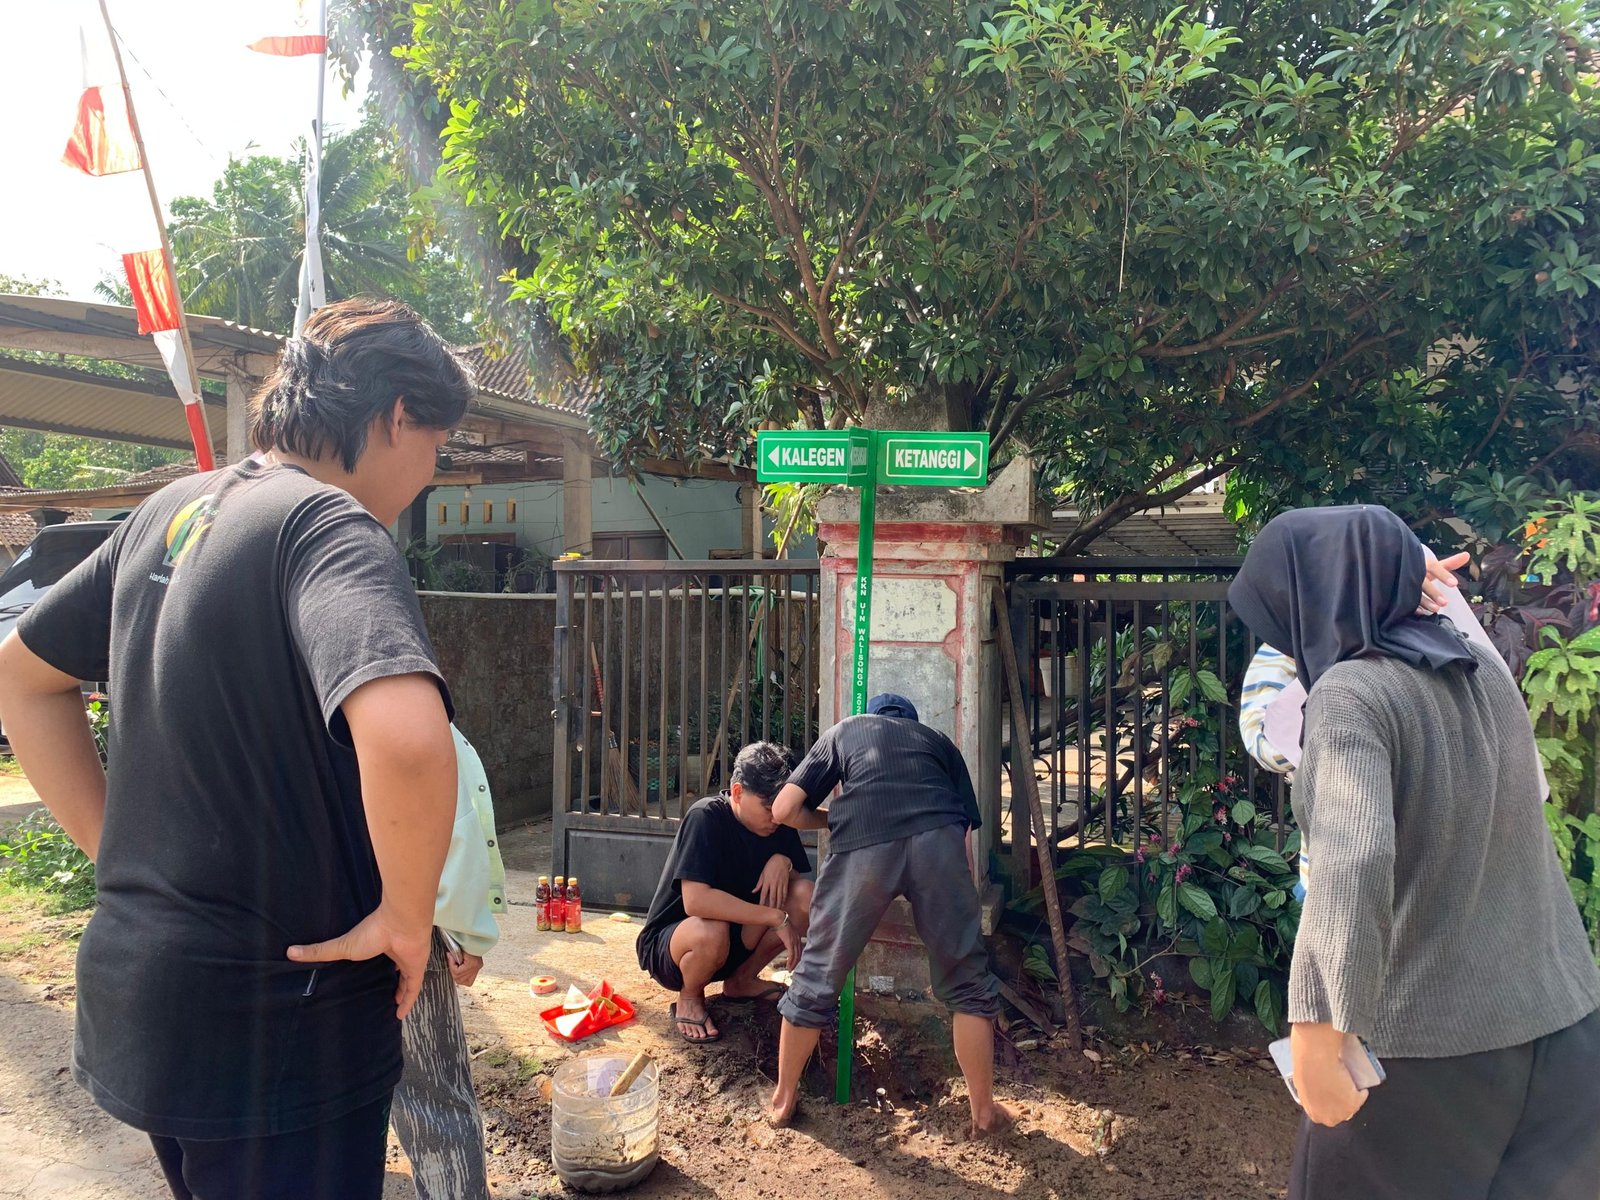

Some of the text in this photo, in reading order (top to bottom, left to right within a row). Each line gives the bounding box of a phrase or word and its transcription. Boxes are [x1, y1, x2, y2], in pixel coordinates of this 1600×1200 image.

[782, 447, 845, 467] KALEGEN
[895, 448, 961, 469] KETANGGI
[856, 628, 866, 687] WALISONGO
